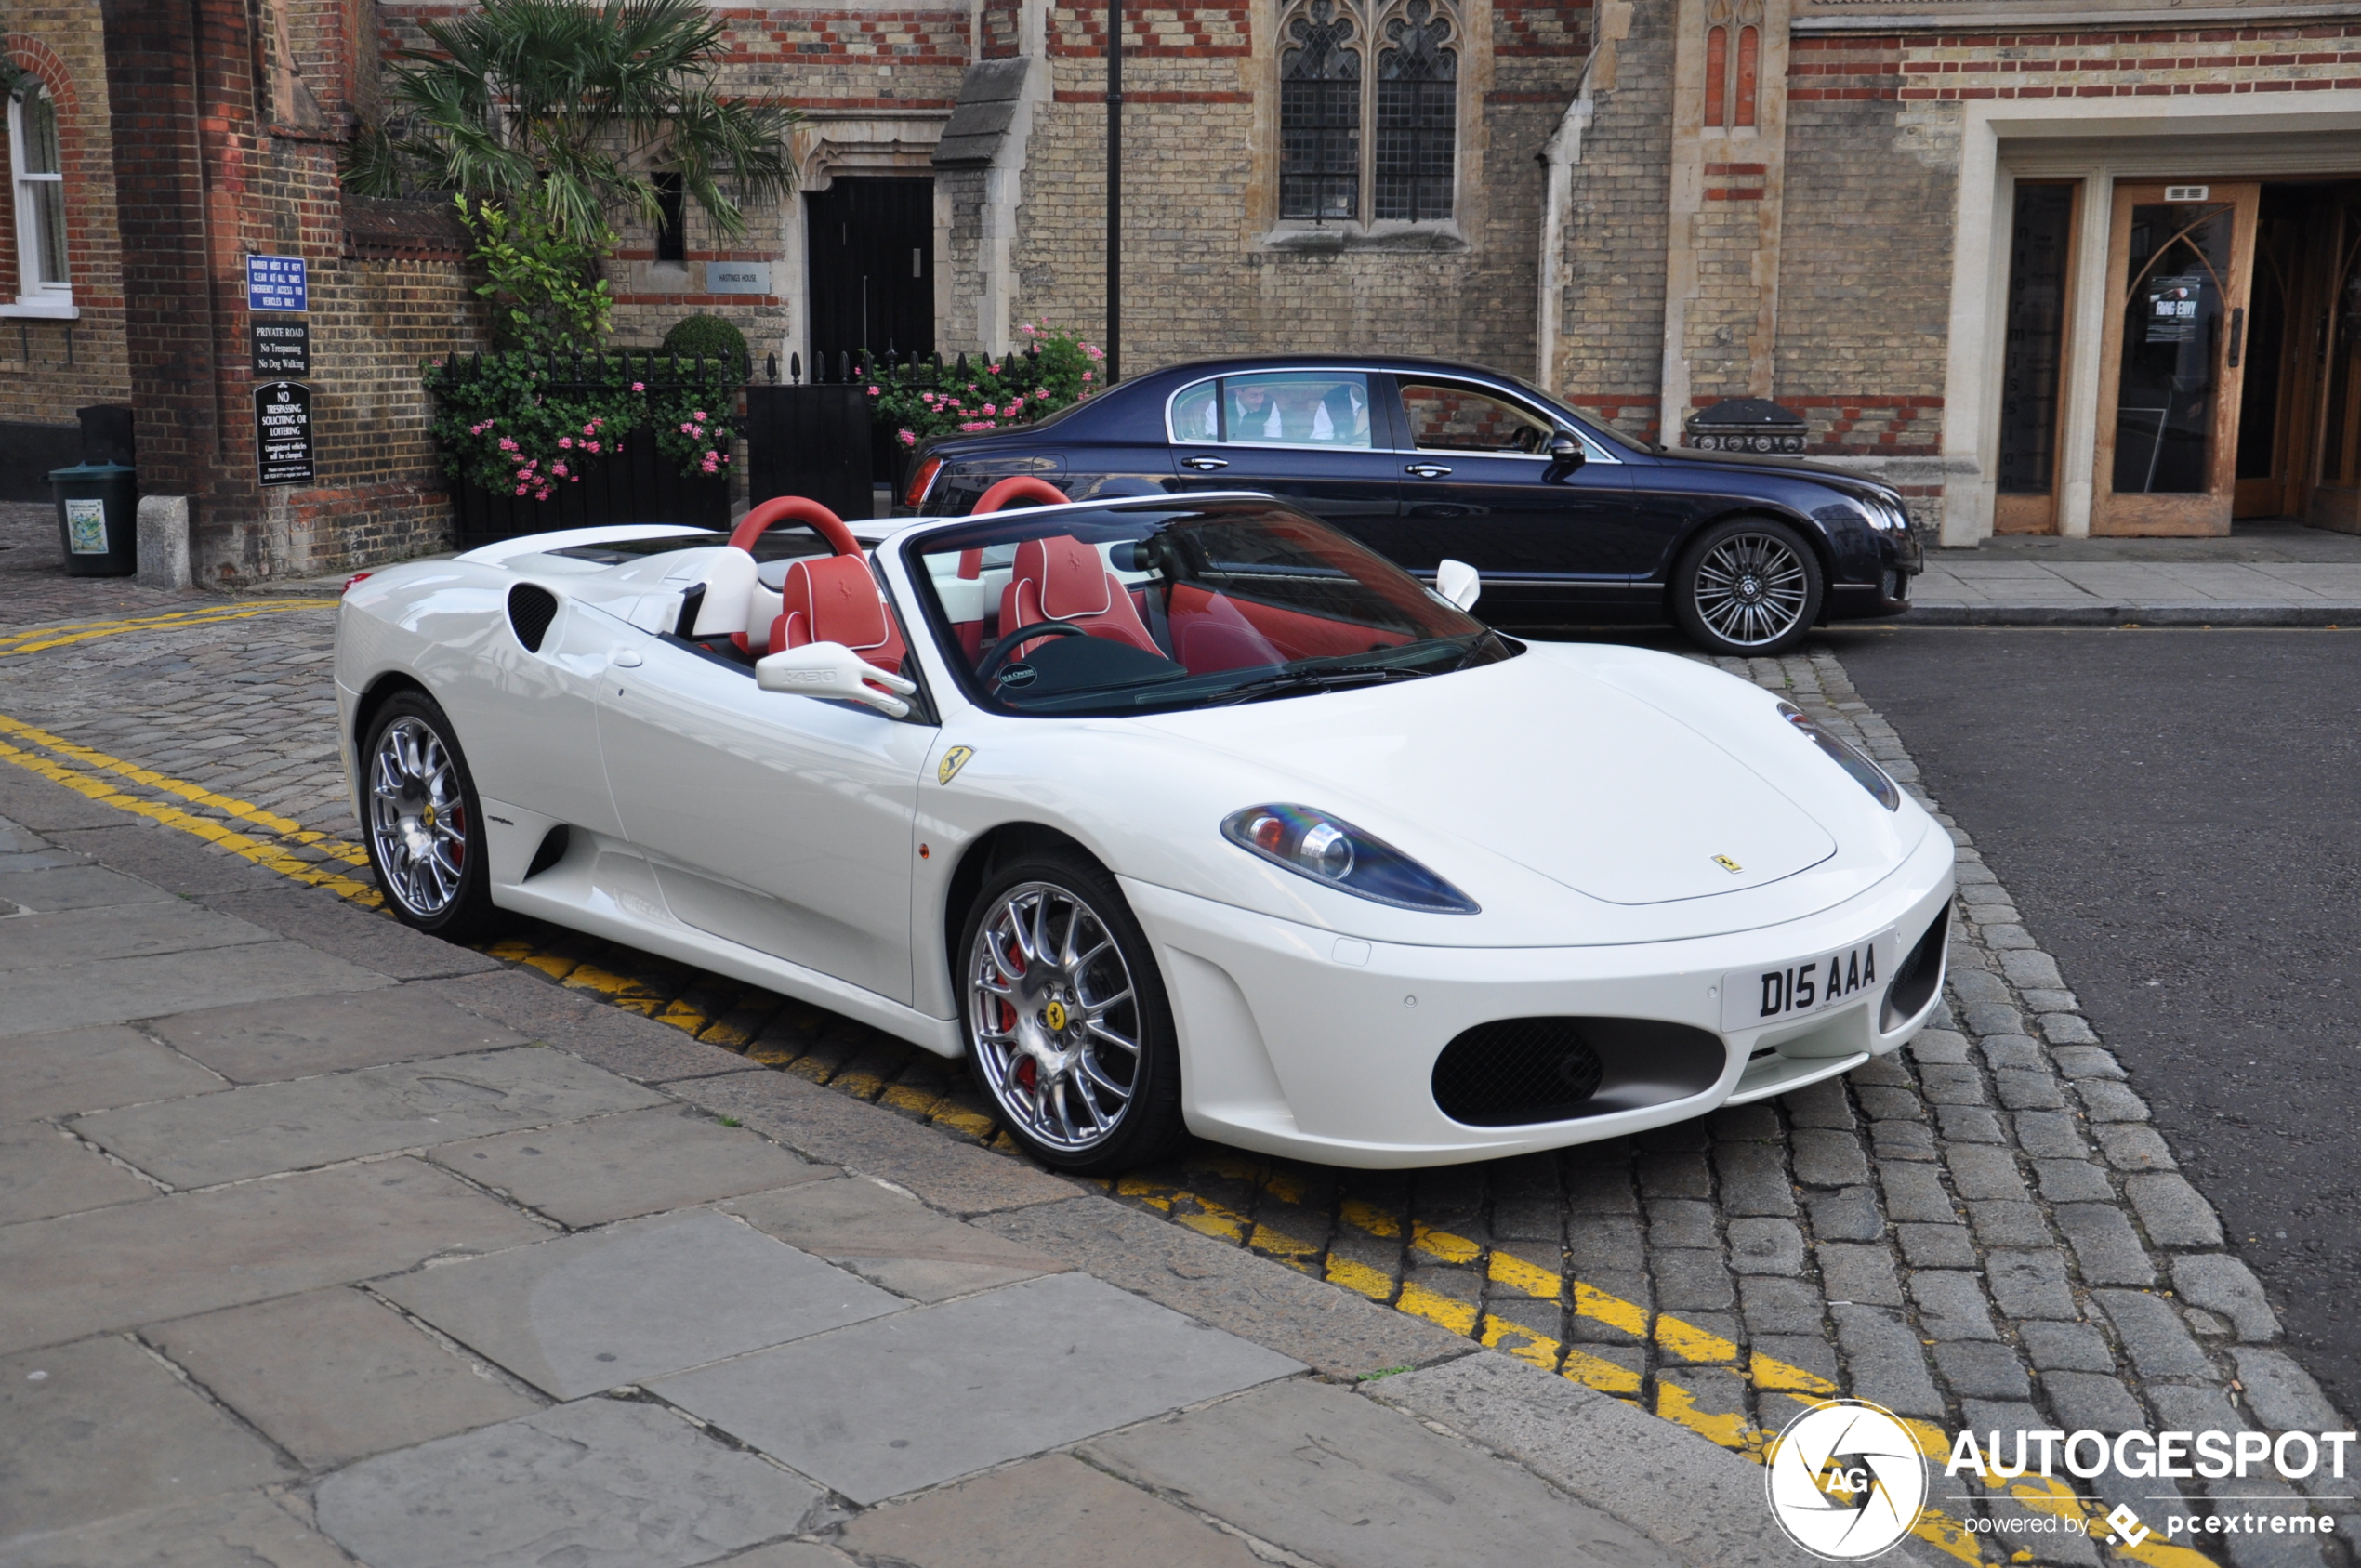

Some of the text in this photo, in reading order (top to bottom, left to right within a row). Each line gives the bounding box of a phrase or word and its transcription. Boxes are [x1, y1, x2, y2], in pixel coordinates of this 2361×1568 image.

[270, 261, 281, 270] MUST
[284, 262, 289, 271] BE
[292, 263, 301, 272] KEPT
[254, 272, 267, 282] CLEAR
[270, 273, 276, 283] AT
[278, 274, 286, 283] ALL
[742, 273, 757, 283] HOUSE
[251, 284, 273, 294] EMERGENCY
[277, 285, 293, 295] ACCESS
[262, 296, 282, 307] VEHICLES
[257, 327, 304, 337] PRIVATE ROAD
[260, 343, 301, 355] No Trespassing
[258, 359, 304, 370] No Dog Walking
[277, 391, 290, 402] NO
[266, 404, 301, 414] TRESPASSING
[262, 415, 307, 426] SOLICITING OR
[270, 426, 300, 437] LOITERING
[265, 441, 307, 453] Unregistered vehicles
[279, 452, 284, 460] be
[1760, 943, 1876, 1018] D15 AAA
